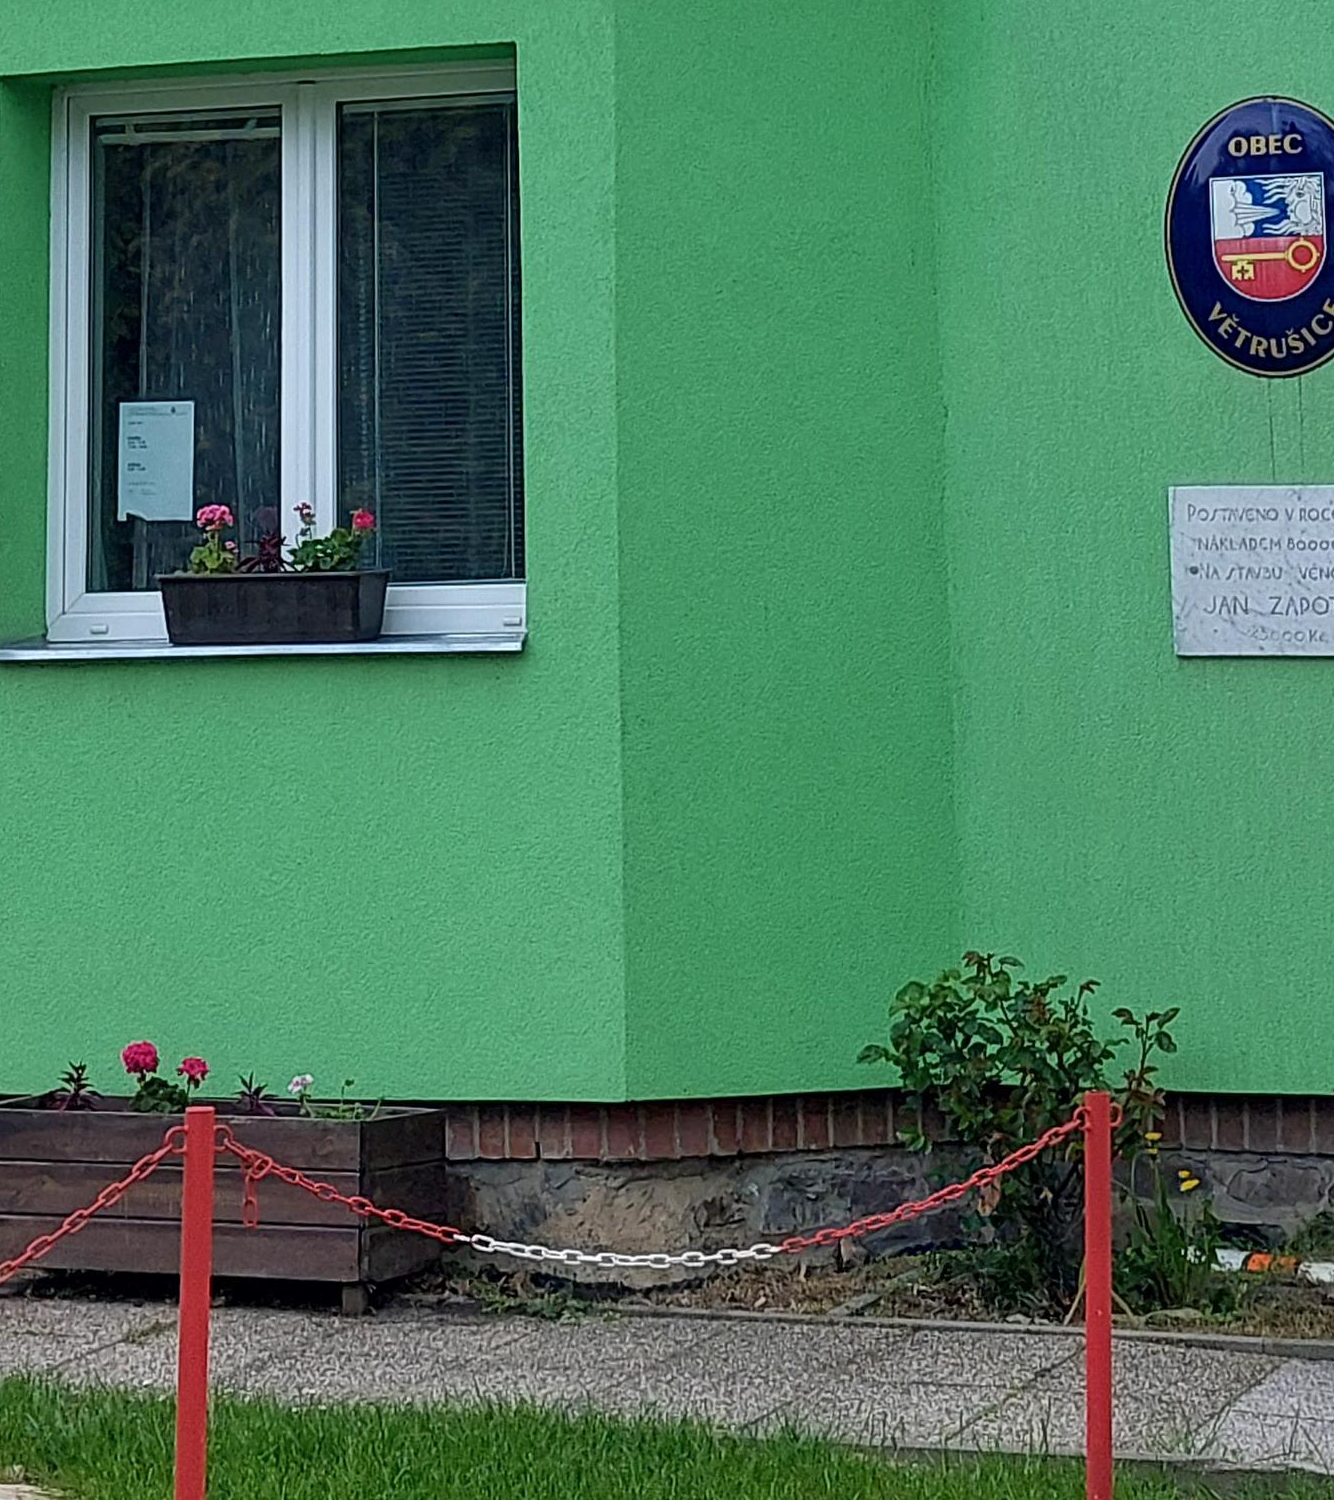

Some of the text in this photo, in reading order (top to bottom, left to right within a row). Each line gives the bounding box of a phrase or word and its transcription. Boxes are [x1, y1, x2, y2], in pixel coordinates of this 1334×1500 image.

[1227, 133, 1303, 157] OBEC
[1285, 507, 1294, 522] V
[1203, 595, 1249, 616] JAN
